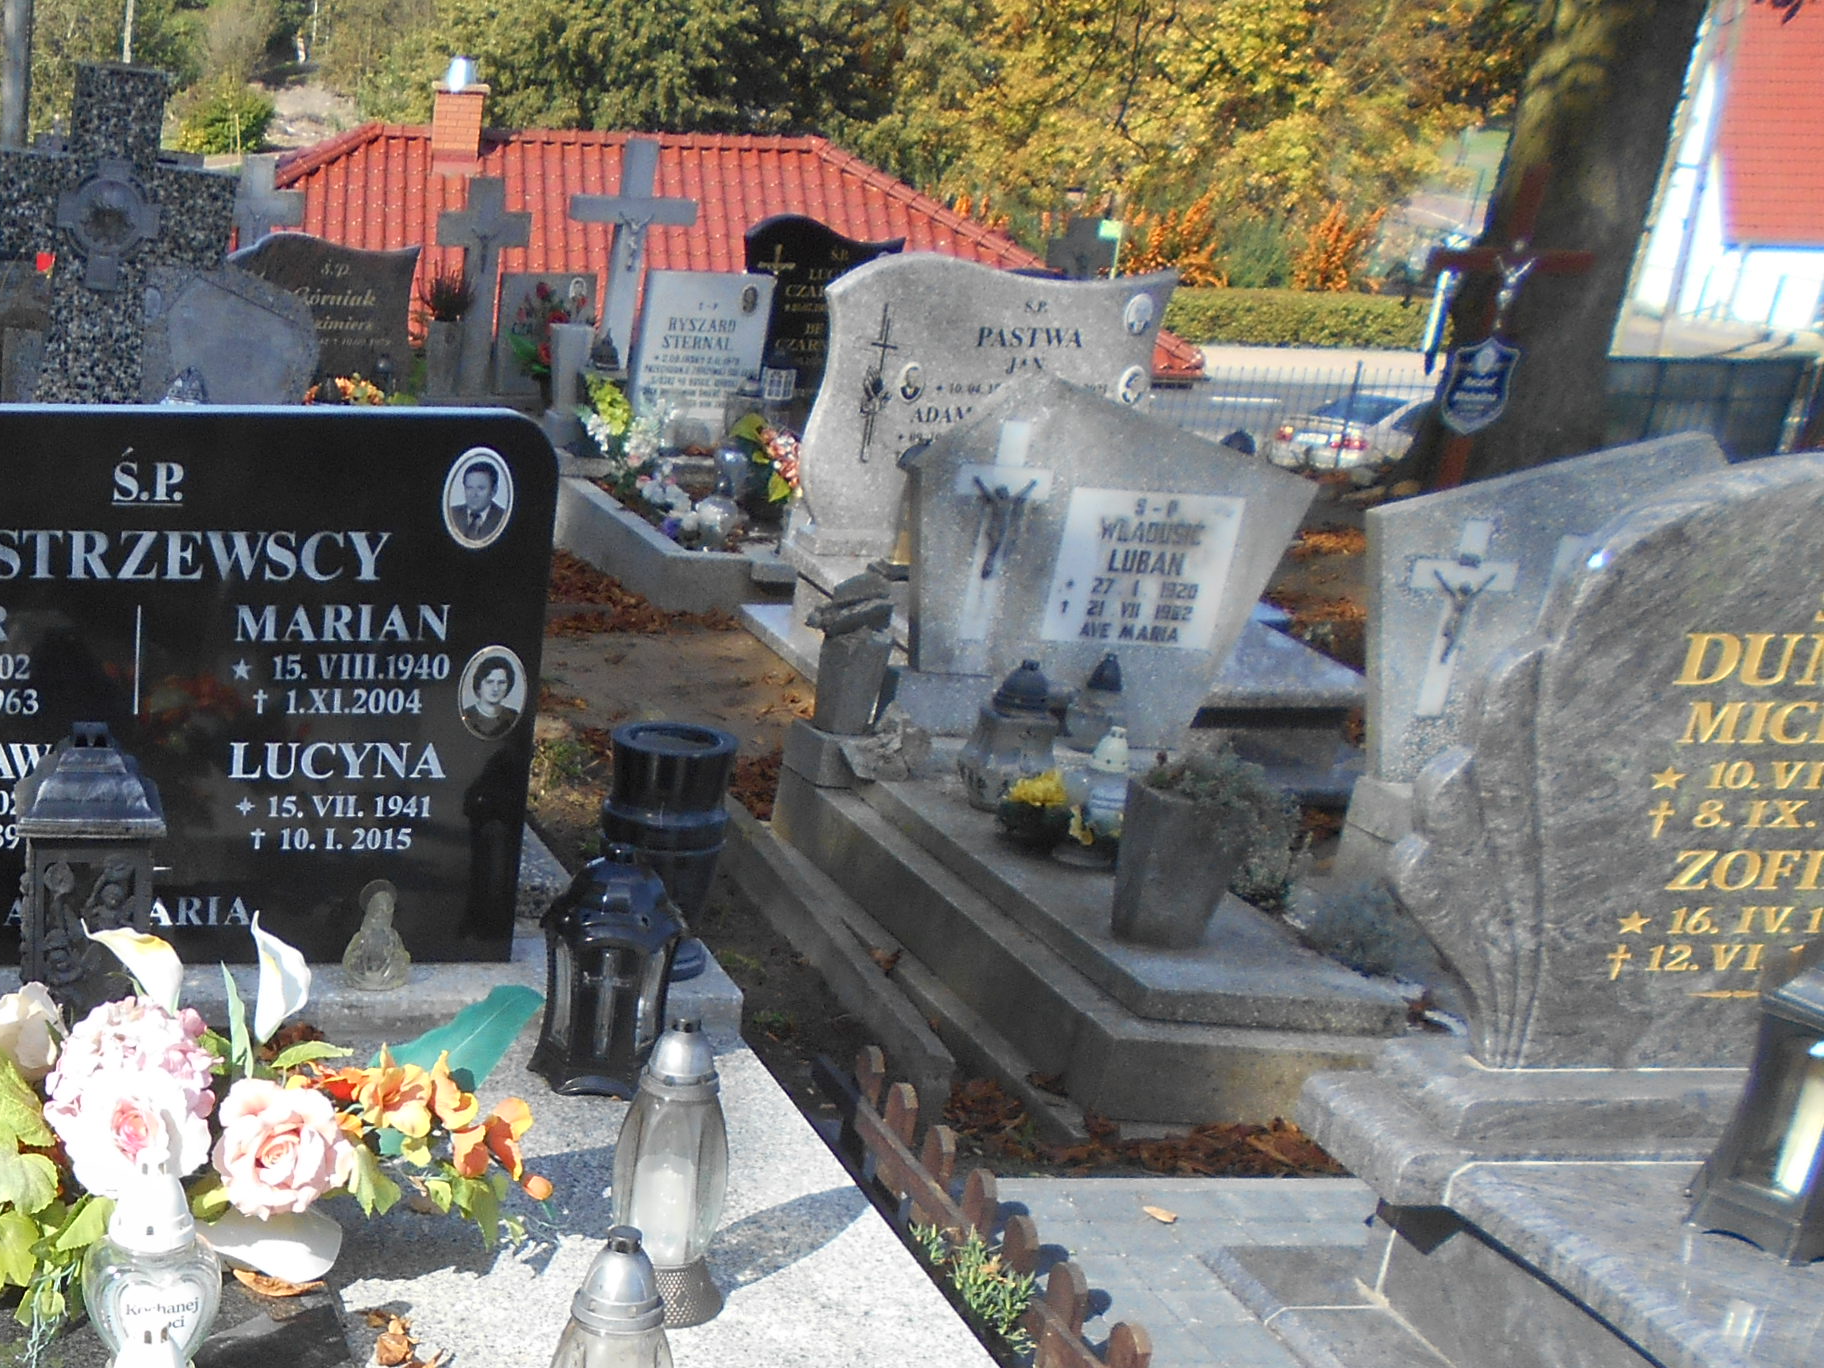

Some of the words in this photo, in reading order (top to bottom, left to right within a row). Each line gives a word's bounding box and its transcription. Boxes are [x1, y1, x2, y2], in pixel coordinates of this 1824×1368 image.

[668, 317, 737, 333] RYSZARD
[977, 326, 1083, 348] PASTWA
[662, 335, 734, 350] STERNAL
[234, 604, 451, 641] MARIAN
[1079, 622, 1112, 638] AVE
[1118, 624, 1179, 642] MARIA
[285, 688, 423, 714] 1.XI.2004
[228, 742, 446, 779] LUCYNA
[1704, 760, 1761, 789] 10.
[374, 795, 432, 818] 1941
[1692, 799, 1732, 828] 8.
[350, 828, 413, 851] 2015
[1663, 850, 1824, 891] ZOFI
[150, 895, 251, 926] ARIA
[1666, 906, 1719, 935] 16.
[1644, 944, 1700, 971] 12.
